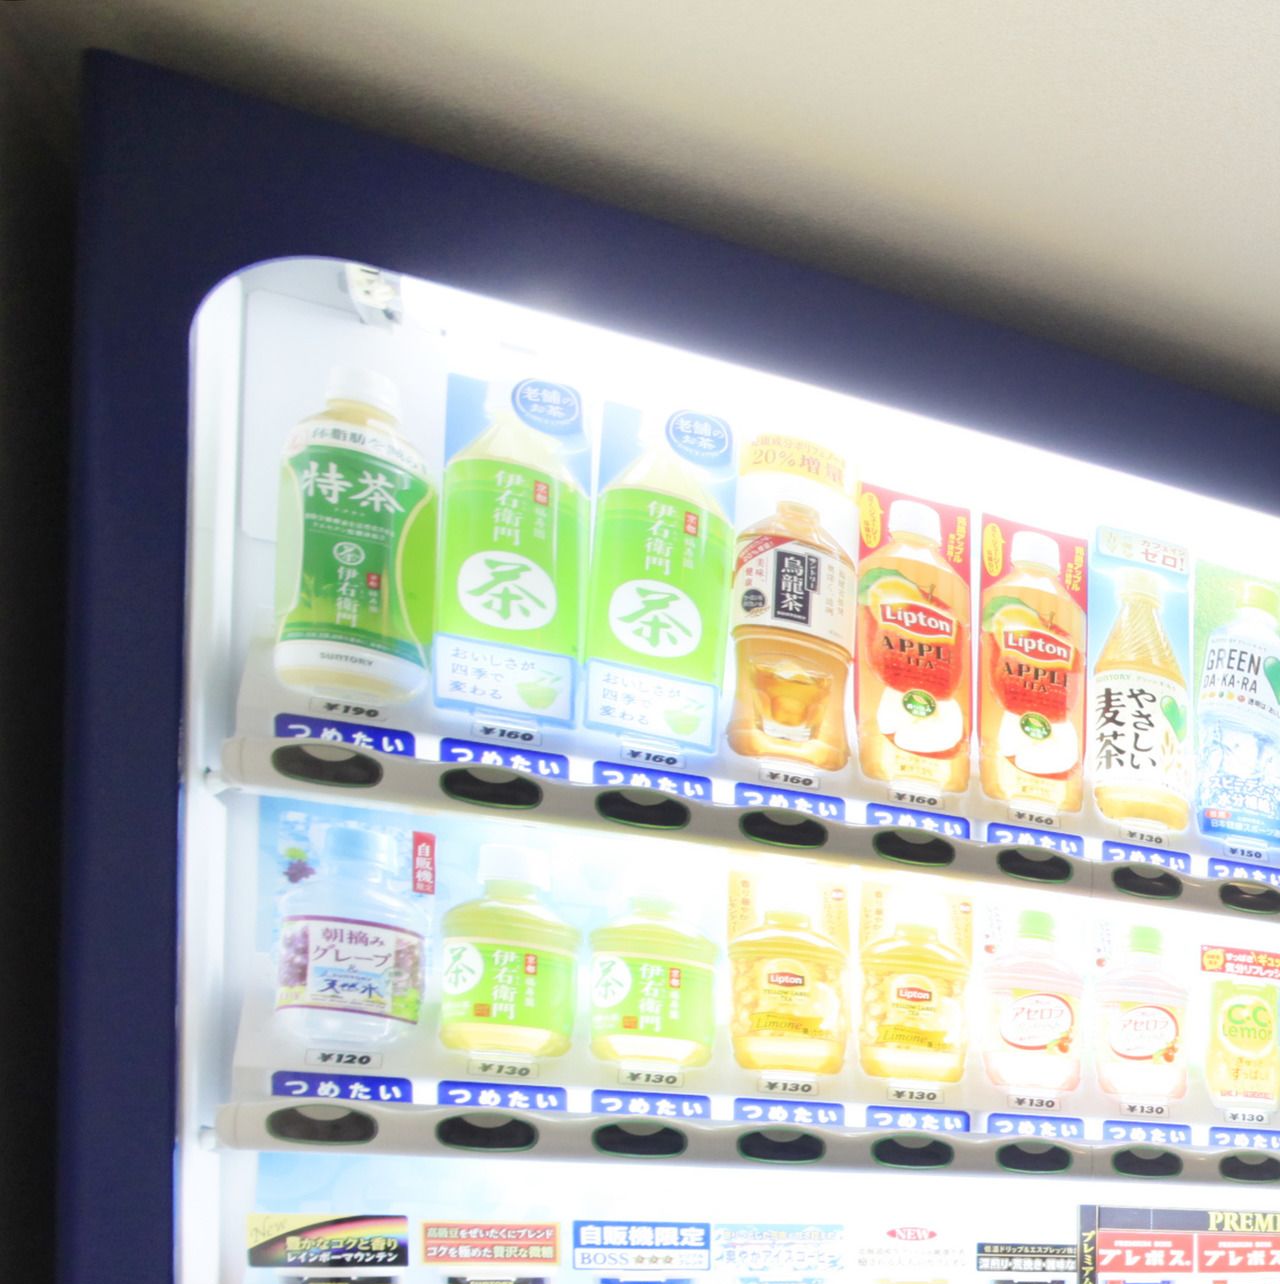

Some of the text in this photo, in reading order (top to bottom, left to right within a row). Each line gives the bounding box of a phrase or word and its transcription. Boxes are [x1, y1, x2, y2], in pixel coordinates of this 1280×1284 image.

[302, 460, 406, 515] 特茶
[492, 469, 524, 547] 伊右衛門
[644, 500, 677, 577] 伊右衛門
[467, 557, 548, 621] 茶
[780, 555, 806, 613] 烏龍茶
[336, 567, 360, 629] 伊右衛門
[615, 589, 694, 649] 茶
[885, 604, 953, 635] Lipton
[1006, 630, 1071, 661] Lipton
[319, 650, 375, 668] SUNTORY
[451, 647, 536, 672] おいしさが
[907, 655, 935, 671] TEA
[1206, 646, 1263, 684] GREEN
[450, 664, 506, 682] 四季で
[449, 679, 503, 701] 変わる
[601, 672, 683, 698] おいしさが
[1022, 679, 1049, 694] TEA
[601, 687, 653, 710] 四季で
[322, 701, 380, 719] ¥190
[599, 704, 650, 726] 変わる
[479, 725, 535, 743] ¥160
[1094, 687, 1127, 771] 麦茶
[1127, 687, 1158, 771] やさしい
[626, 748, 678, 767] ¥160
[766, 771, 814, 787] ¥160
[893, 793, 939, 807] ¥160
[1014, 814, 1055, 827] ¥160
[1127, 830, 1164, 846] ¥130
[1228, 848, 1263, 861] ¥150
[321, 926, 387, 950] 朝摘み
[311, 943, 394, 969] グレープ
[319, 976, 384, 998] 天然水
[491, 948, 519, 1021] 伊右衛門
[769, 972, 804, 987] Lipton
[638, 962, 665, 1033] 伊右衛門
[897, 988, 931, 1002] Lipton
[319, 1052, 372, 1067] ¥120
[478, 1062, 532, 1077] ¥130
[626, 1071, 678, 1086] ¥130
[766, 1081, 812, 1094] ¥130
[284, 1079, 403, 1101] つめたい
[447, 1087, 559, 1109] つめたい
[892, 1090, 938, 1102] ¥130
[599, 1095, 704, 1117] つめたい
[1013, 1097, 1056, 1109] ¥130
[742, 1104, 839, 1125] つめたい
[873, 1112, 964, 1132] つめたい
[994, 1118, 1080, 1138] つめたい
[1108, 1124, 1187, 1144] つめたい
[579, 1225, 706, 1249] 自販機限定
[892, 1227, 931, 1241] NEW
[286, 1251, 399, 1265] レインボーマウンテン
[579, 1251, 630, 1267] BOSS
